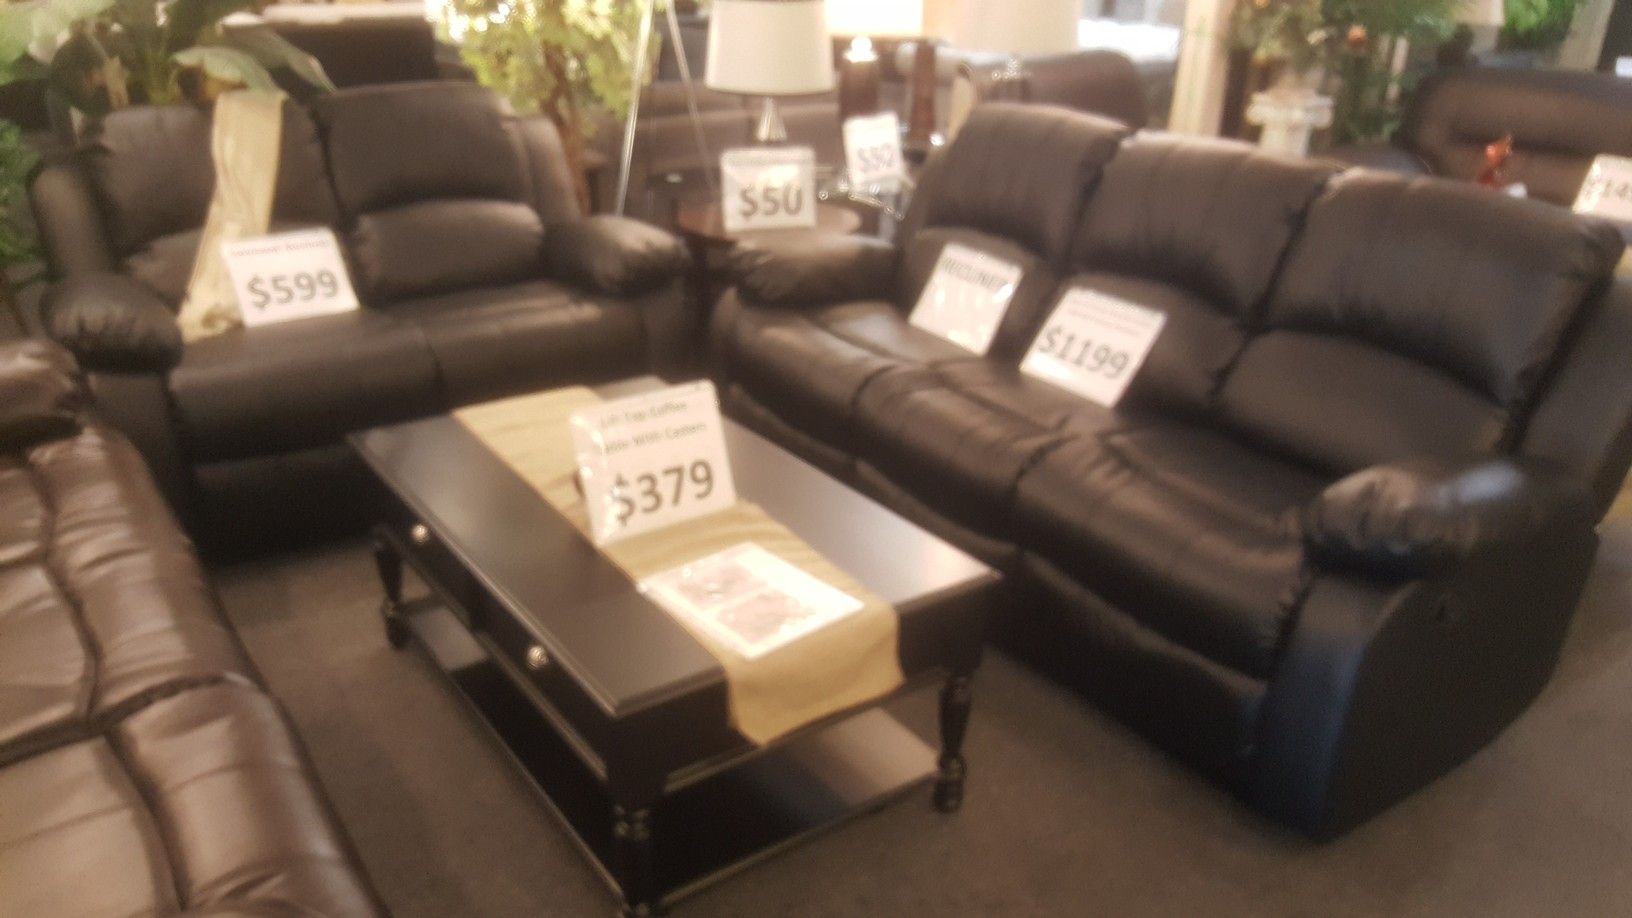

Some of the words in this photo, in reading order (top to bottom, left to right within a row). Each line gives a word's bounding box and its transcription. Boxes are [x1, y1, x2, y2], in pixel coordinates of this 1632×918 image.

[739, 182, 805, 220] $50
[247, 268, 340, 311] $599
[1038, 324, 1130, 380] $1199
[611, 458, 715, 527] $379
